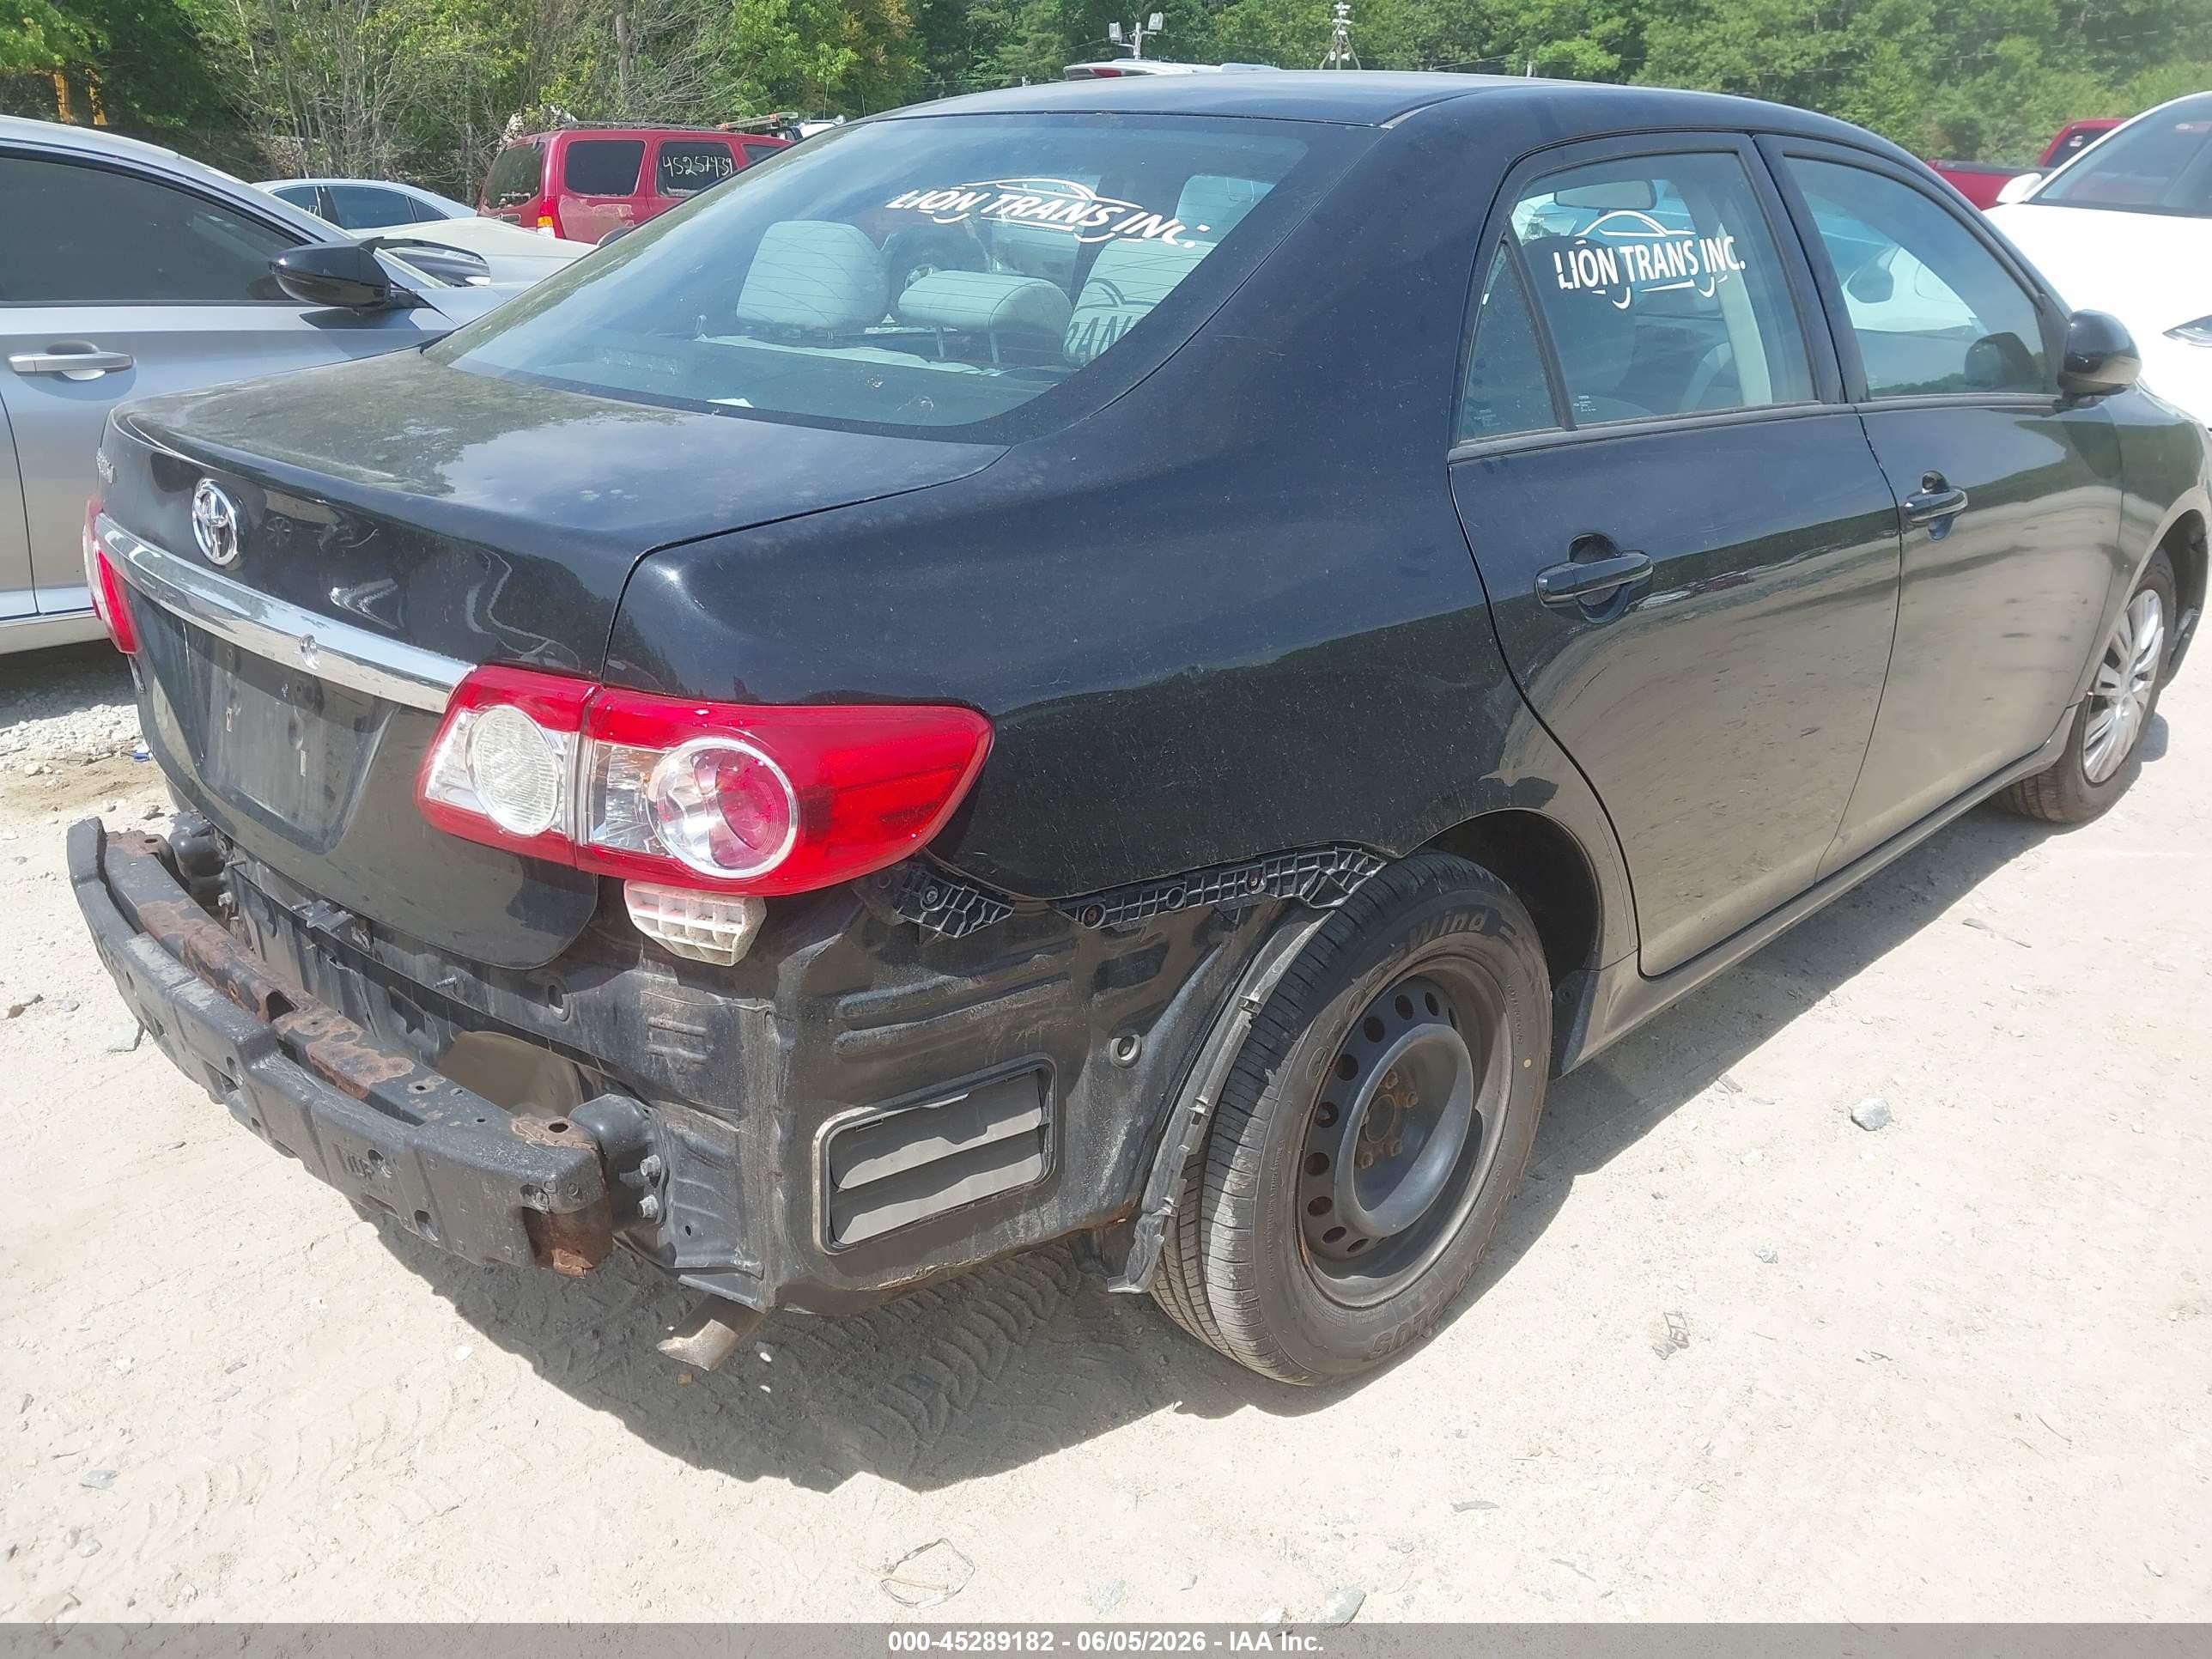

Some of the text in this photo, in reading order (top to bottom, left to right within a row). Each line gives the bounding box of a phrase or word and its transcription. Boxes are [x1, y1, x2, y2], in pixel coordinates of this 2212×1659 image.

[662, 155, 733, 179] 45257439
[884, 190, 991, 211] LION
[981, 193, 1125, 227] TRANS
[1553, 235, 1747, 289] LION TRANS INC.
